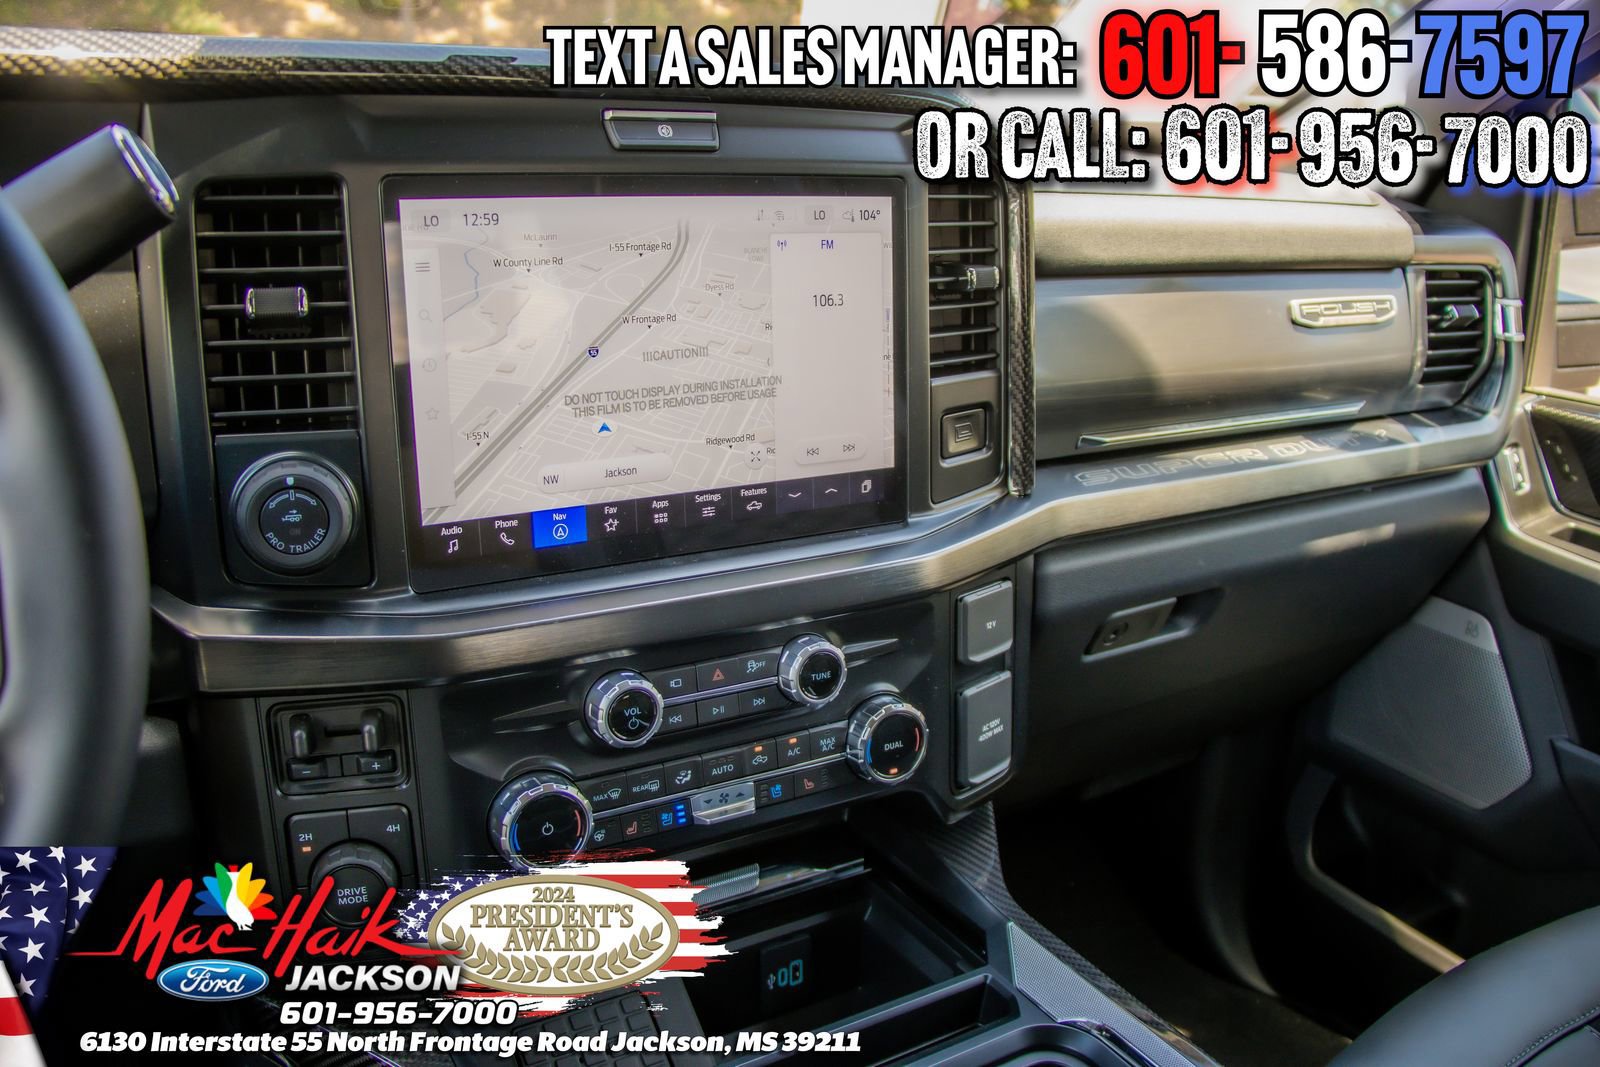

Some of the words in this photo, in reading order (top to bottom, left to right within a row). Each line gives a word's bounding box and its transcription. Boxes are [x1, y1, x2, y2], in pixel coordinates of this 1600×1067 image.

[463, 213, 500, 227] 12:59
[813, 210, 826, 221] LO
[859, 209, 881, 221] 104°
[423, 215, 439, 227] LO
[625, 242, 660, 253] Frontage
[661, 242, 672, 251] Rd
[821, 240, 834, 250] FM
[493, 259, 501, 268] W
[503, 258, 532, 268] County
[534, 258, 552, 267] Line
[553, 257, 563, 266] Rd
[705, 283, 724, 292] Dyess
[724, 282, 735, 290] Rd
[812, 294, 844, 307] 106.3
[622, 316, 630, 325] W
[631, 315, 666, 325] Frontage
[666, 314, 677, 323] Rd
[564, 394, 580, 406] DO
[582, 392, 603, 405] NOT
[604, 389, 639, 402] TOUCH
[641, 384, 681, 399] DISPLAY
[682, 381, 719, 394] DURING
[720, 375, 783, 391] INSTALLATION
[572, 406, 596, 418] THIS
[597, 404, 620, 415] FILM
[623, 402, 631, 413] IS
[632, 400, 647, 412] TO
[648, 399, 661, 410] BE
[662, 394, 709, 409] REMOVED
[710, 390, 747, 404] BEFORE
[747, 387, 777, 400] USAGE
[483, 431, 490, 440] N
[705, 435, 744, 446] Ridgewood
[744, 433, 756, 442] Rd
[604, 465, 638, 478] Jackson
[543, 476, 559, 485] NW
[740, 486, 768, 497] Features
[695, 492, 722, 504] Settings
[604, 505, 618, 515] Fav
[652, 499, 670, 510] Apps
[552, 512, 567, 521] Nav
[494, 518, 519, 529] Phone
[441, 526, 463, 536] Audio
[265, 532, 285, 550] PRO
[289, 528, 326, 553] TRAILER
[811, 671, 831, 681] TUNE
[624, 708, 642, 716] VOL
[820, 737, 836, 746] MAX
[884, 740, 903, 751] DUAL
[787, 748, 800, 757] A/C
[822, 743, 835, 752] A/C
[711, 764, 734, 776] AUTO
[593, 793, 608, 802] MAX
[386, 823, 400, 833] 4H
[298, 833, 313, 842] 2H
[337, 886, 367, 897] DRIVE
[338, 894, 368, 905] MODE
